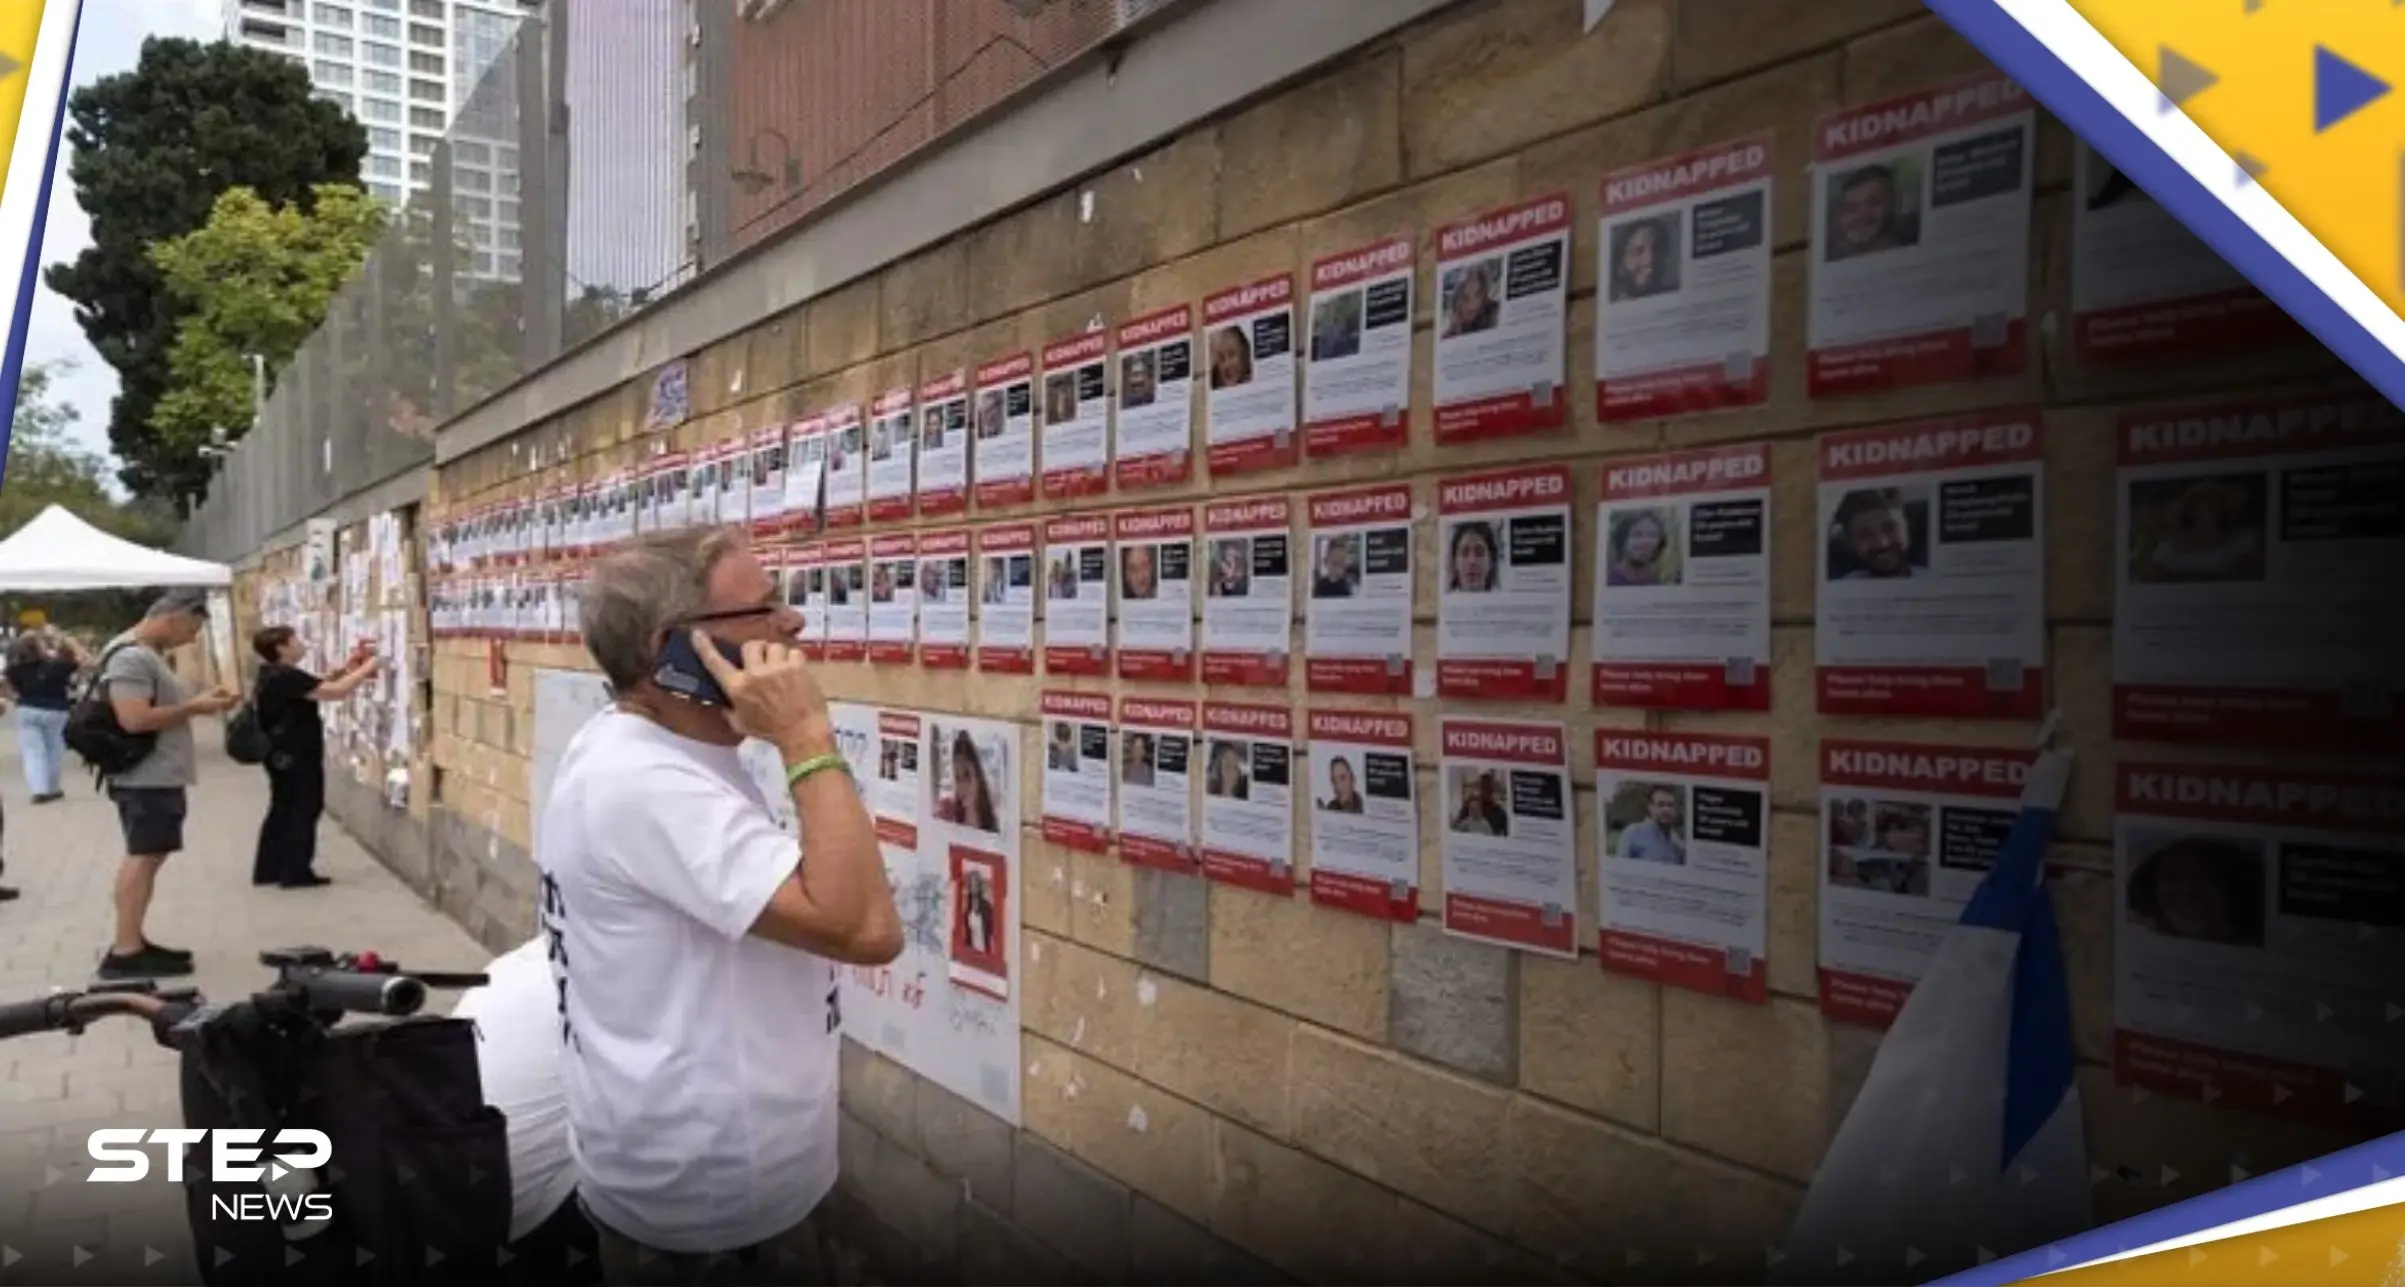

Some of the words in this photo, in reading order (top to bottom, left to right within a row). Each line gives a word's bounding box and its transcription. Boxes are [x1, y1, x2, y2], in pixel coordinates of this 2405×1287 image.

[1606, 145, 1765, 204] KIDNAPPED
[1442, 201, 1564, 252] KIDNAPPED
[1317, 243, 1409, 281] KIDNAPPED
[1207, 280, 1290, 313] KIDNAPPED
[1829, 422, 2033, 468] KIDNAPPED
[1609, 455, 1763, 490] KIDNAPPED
[1444, 475, 1563, 504] KIDNAPPED
[1119, 511, 1190, 532] KIDNAPPED
[1208, 504, 1287, 524] KIDNAPPED
[1313, 494, 1406, 520] KIDNAPPED
[1046, 697, 1107, 712] KIDNAPPED
[1124, 703, 1193, 722] KIDNAPPED
[1207, 707, 1287, 728] KIDNAPPED
[1313, 716, 1408, 737] KIDNAPPED
[1447, 731, 1556, 754] KIDNAPPED
[1602, 739, 1762, 768] KIDNAPPED
[1830, 749, 2026, 783] KIDNAPPED
